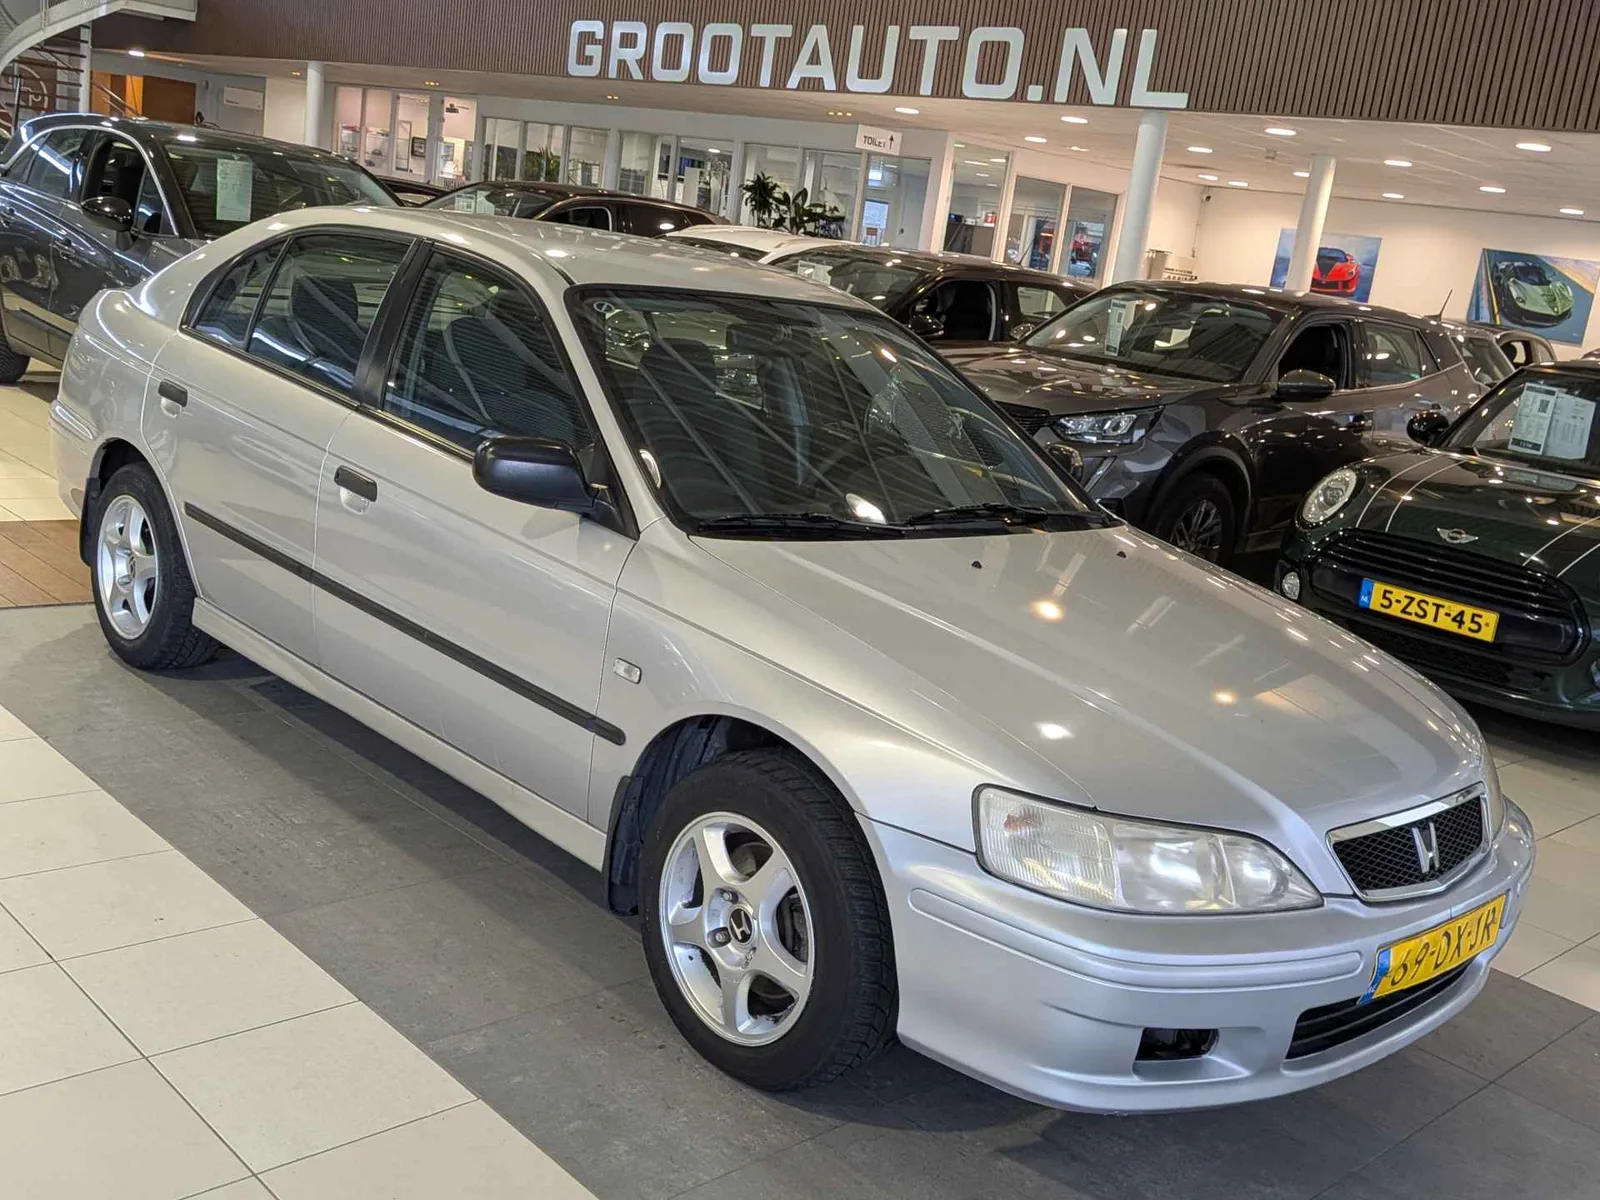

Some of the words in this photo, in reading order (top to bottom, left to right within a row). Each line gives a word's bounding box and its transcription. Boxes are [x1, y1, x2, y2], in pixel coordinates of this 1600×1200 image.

[567, 20, 1189, 109] GROOTAUTO.NL
[1380, 589, 1483, 633] 5-ZST-45
[1391, 906, 1498, 986] 69-DX-JR
